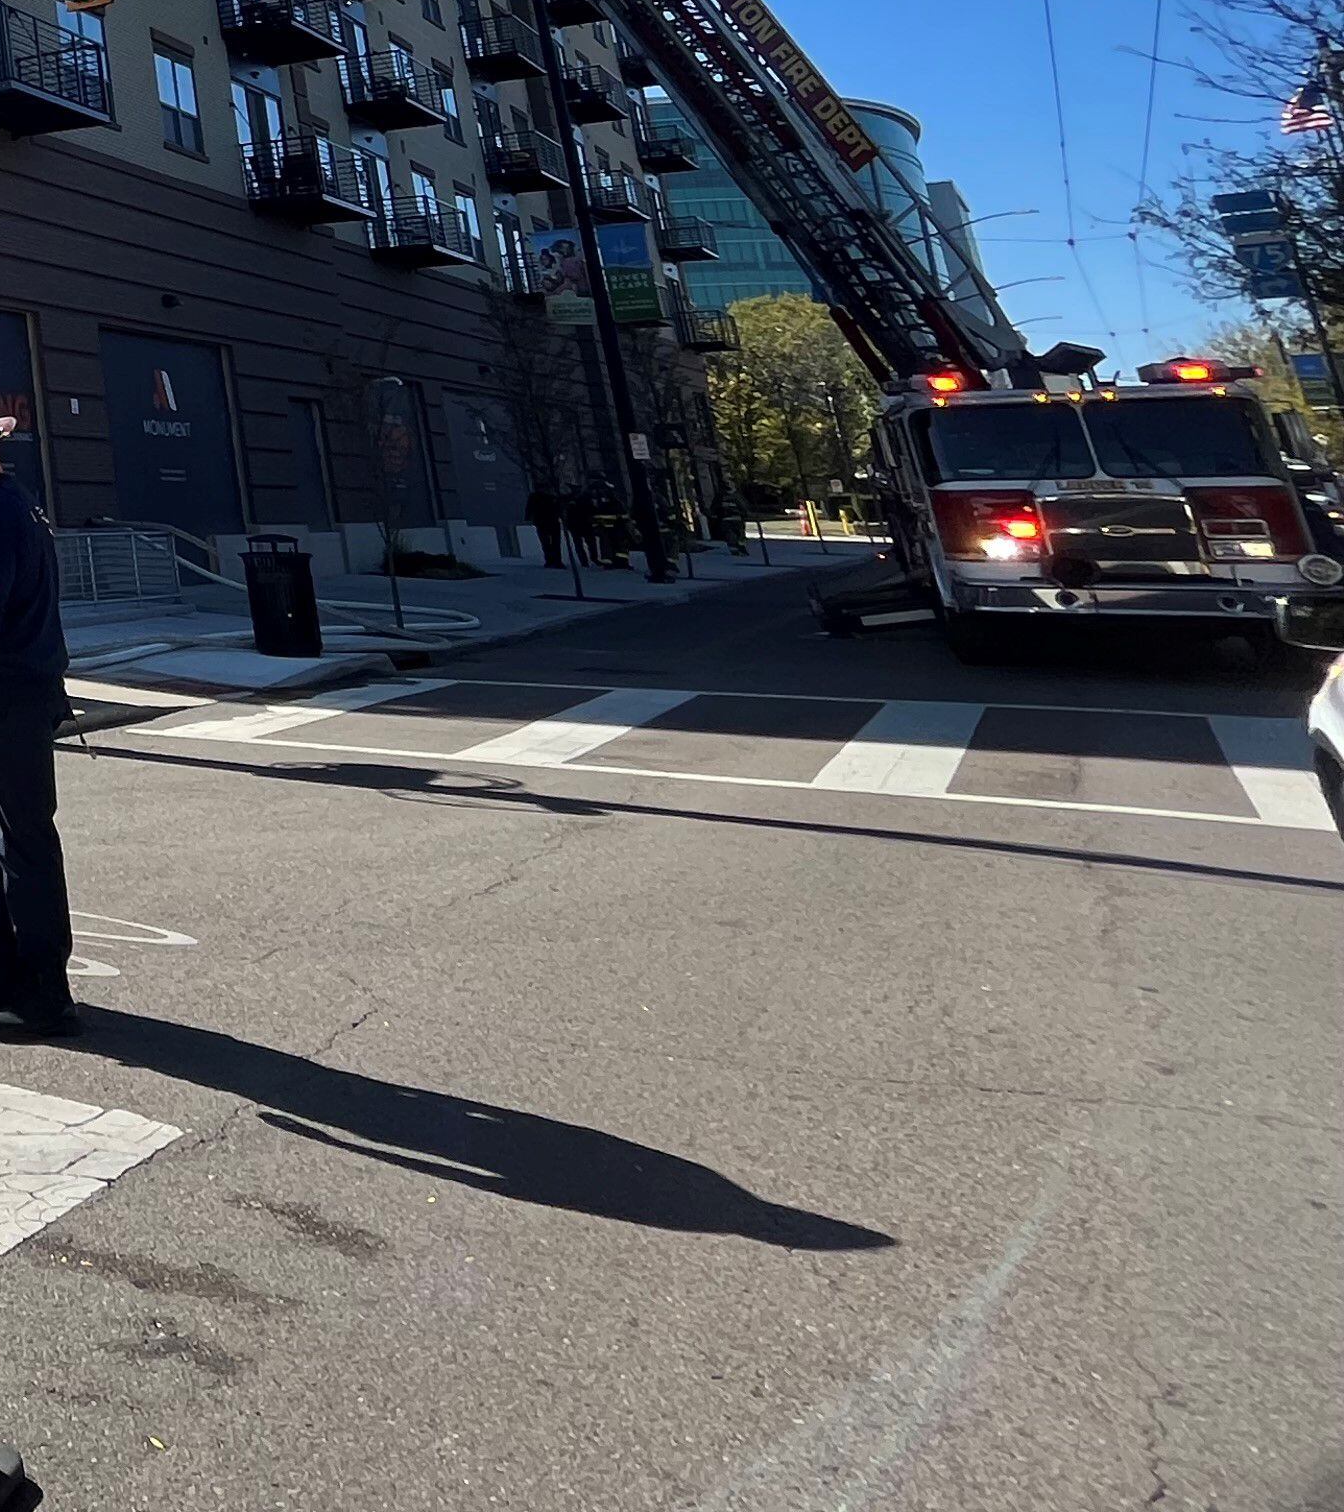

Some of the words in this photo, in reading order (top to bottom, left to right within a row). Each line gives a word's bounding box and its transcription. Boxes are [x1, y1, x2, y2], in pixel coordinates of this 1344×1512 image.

[770, 42, 822, 98] FIRE
[813, 94, 872, 161] DEPT
[1242, 244, 1287, 270] 75
[142, 419, 192, 438] MONUMENT
